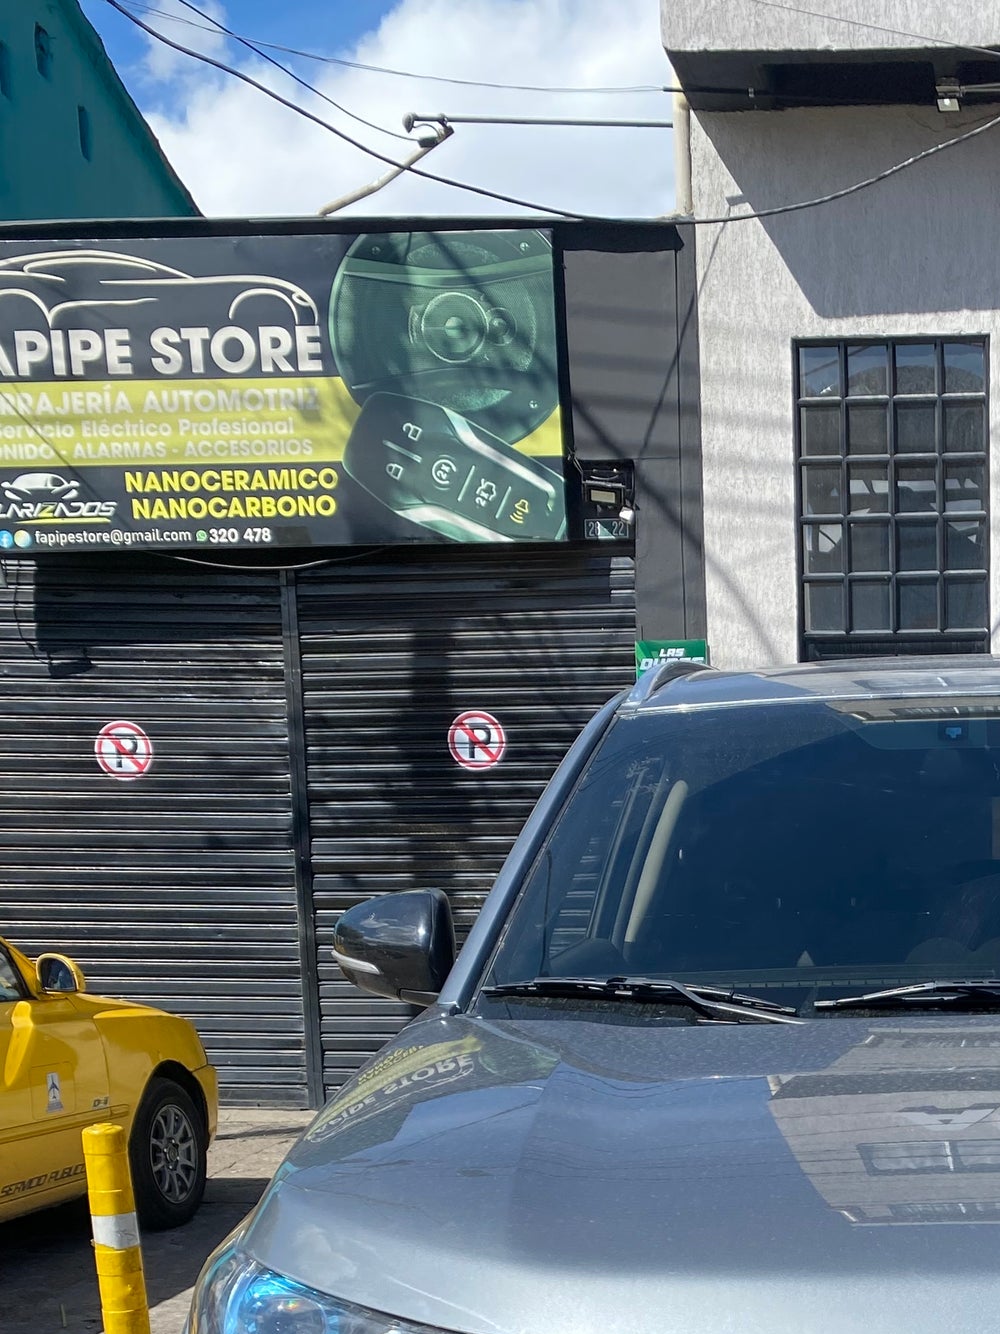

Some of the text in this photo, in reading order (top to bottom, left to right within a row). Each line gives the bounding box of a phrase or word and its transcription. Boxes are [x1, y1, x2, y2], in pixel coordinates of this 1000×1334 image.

[150, 325, 323, 374] STORE
[142, 388, 319, 413] AUTOMOTRIZ
[0, 416, 294, 439] ervicio Eléctrico Profesional
[0, 443, 56, 460] NIDO
[73, 441, 167, 459] ALARMAS
[184, 438, 313, 457] ACCESORIOS
[124, 467, 339, 493] NANOCERAMICO
[131, 495, 337, 520] NANOCARBONO
[34, 529, 192, 547] fapipestore@gmail.com
[209, 527, 272, 543] 320 478
